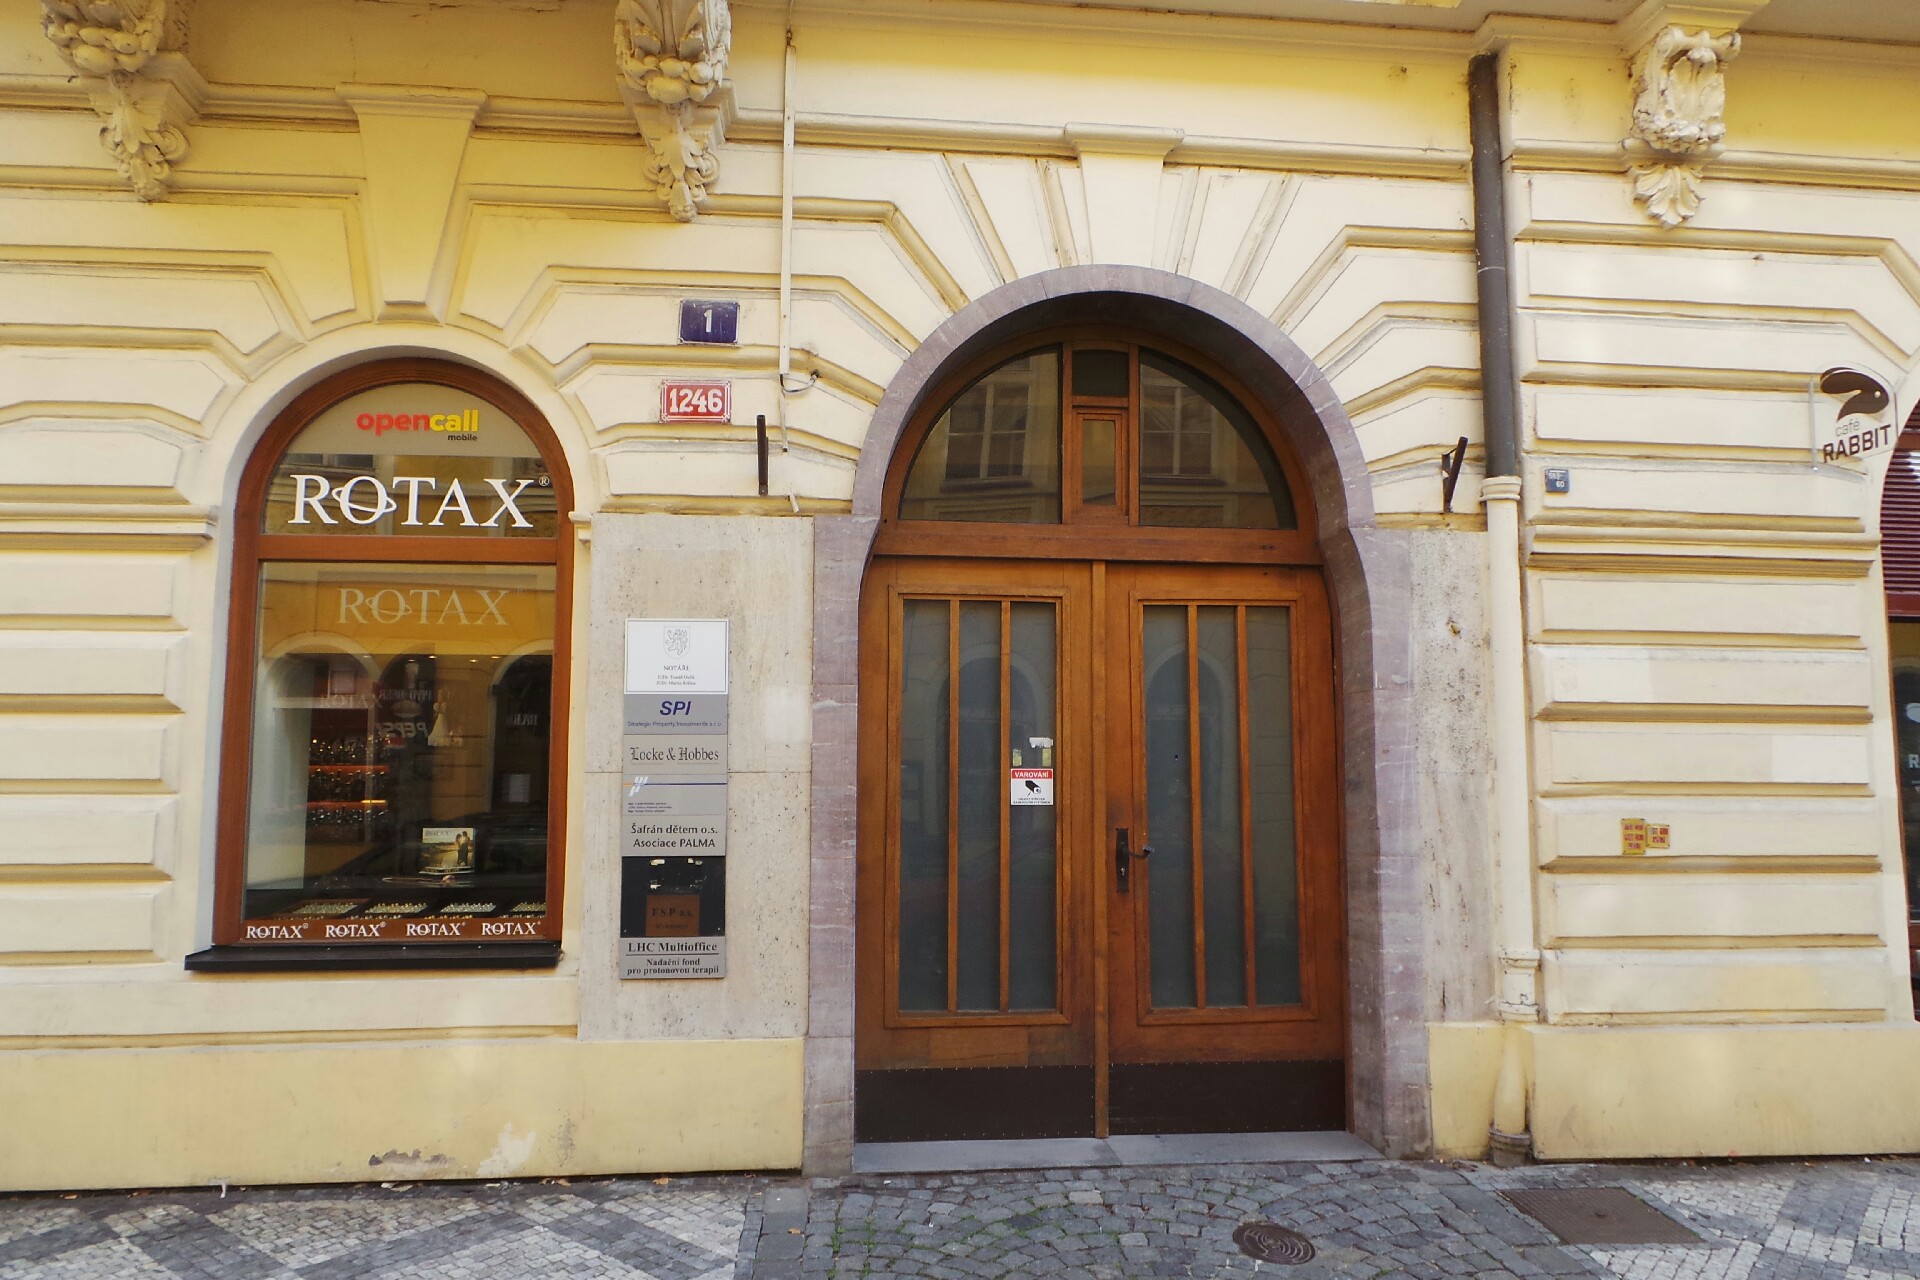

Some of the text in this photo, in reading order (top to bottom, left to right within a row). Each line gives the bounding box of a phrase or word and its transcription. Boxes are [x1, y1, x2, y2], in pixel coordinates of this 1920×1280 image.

[704, 310, 712, 332] 1
[669, 388, 722, 413] 1246
[355, 409, 478, 436] opencall
[1835, 418, 1860, 437] café
[447, 433, 478, 441] mobile
[1822, 424, 1891, 464] RABBIT
[337, 588, 512, 626] ROTAX
[660, 701, 691, 715] SPI
[630, 746, 719, 760] Locke & Hobbes
[1014, 770, 1049, 778] VAROVÁNÍ
[631, 822, 663, 833] Šafrán
[666, 824, 698, 833] dětem
[633, 838, 715, 847] Asociace PALMA
[628, 941, 717, 952] LHC Multioffice
[646, 958, 700, 966] Nadační fond
[627, 965, 719, 976] pro protonovou terapii
